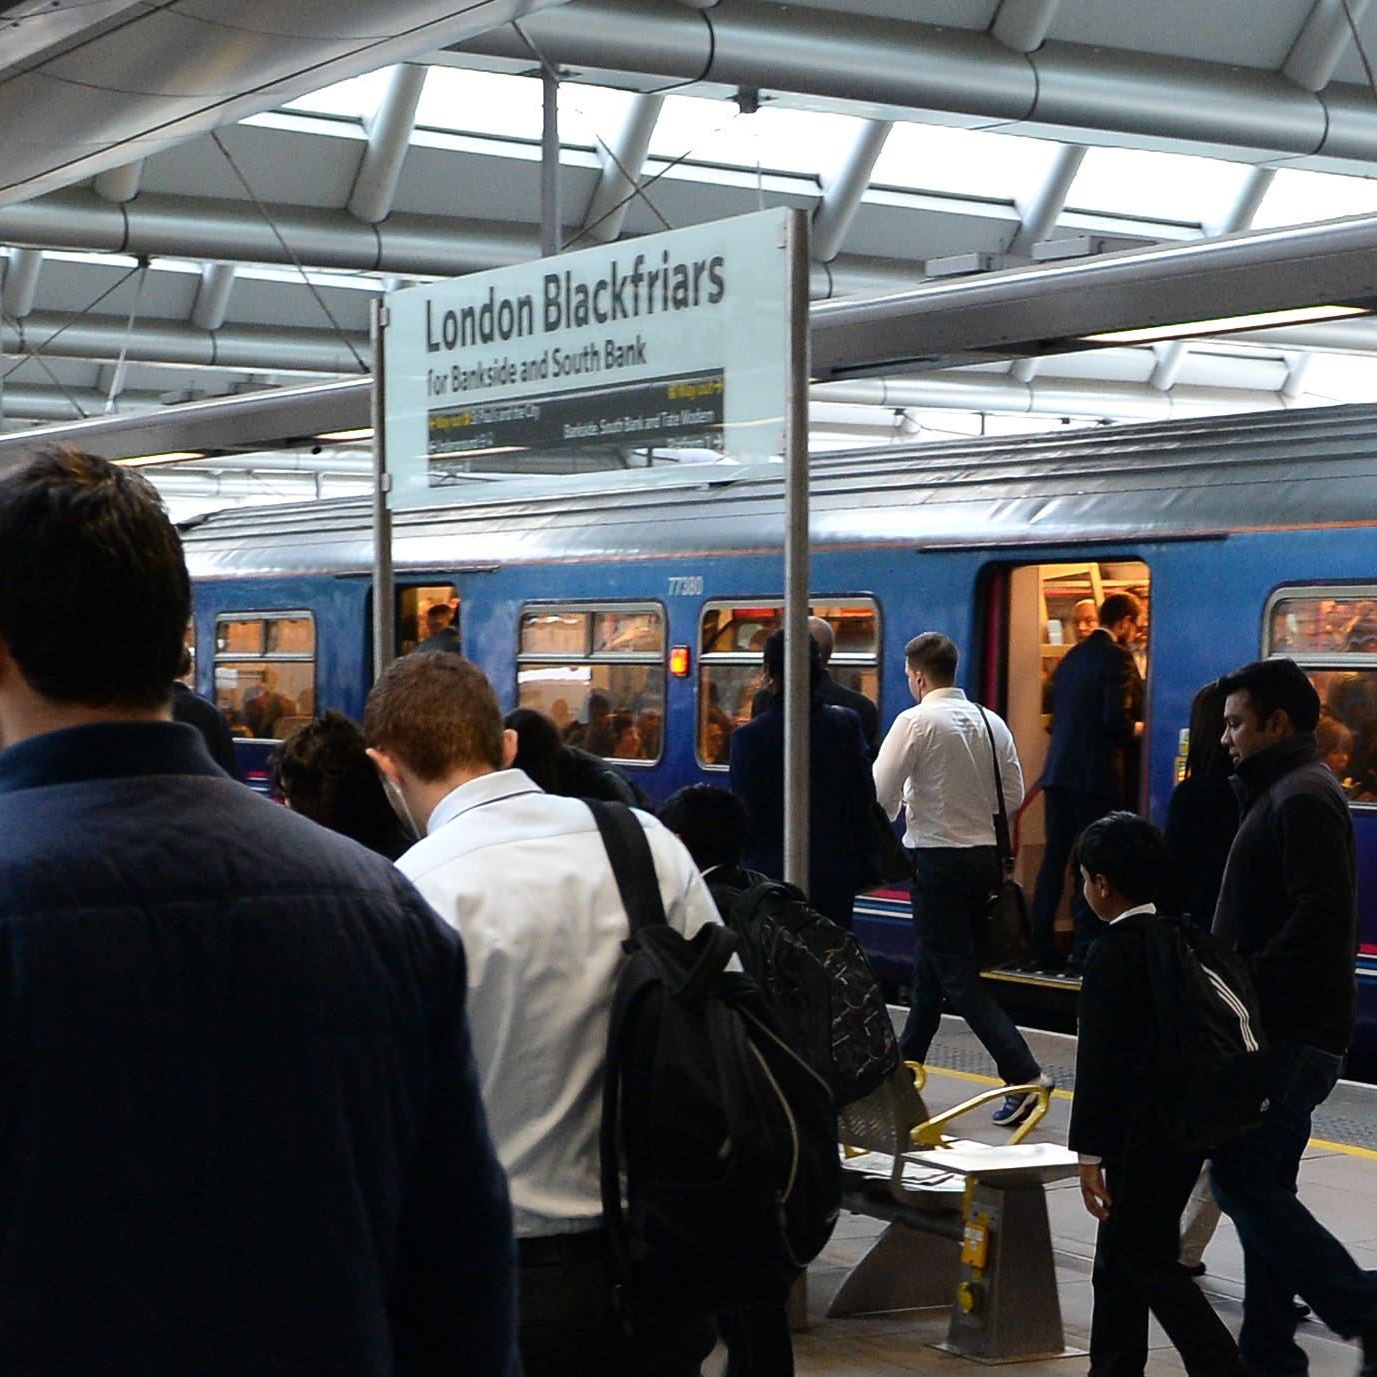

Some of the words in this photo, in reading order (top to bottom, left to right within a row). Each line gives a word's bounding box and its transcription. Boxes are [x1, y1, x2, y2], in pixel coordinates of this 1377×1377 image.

[426, 286, 534, 352] London
[543, 250, 726, 333] Blackfriars
[427, 368, 448, 396] for
[451, 358, 518, 391] Bankside
[520, 350, 549, 382] and
[552, 342, 600, 377] South
[606, 334, 647, 367] Bank
